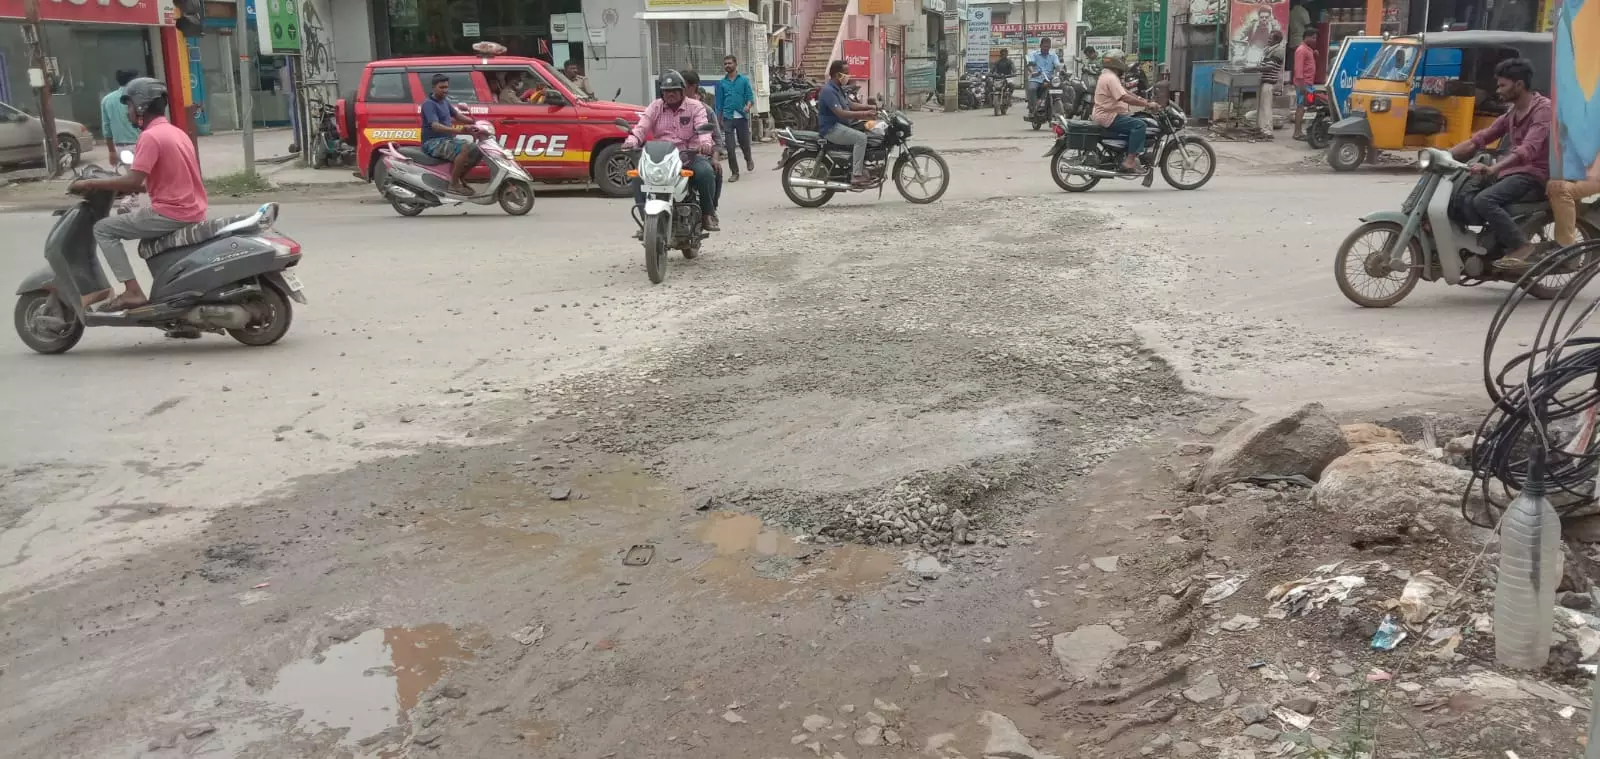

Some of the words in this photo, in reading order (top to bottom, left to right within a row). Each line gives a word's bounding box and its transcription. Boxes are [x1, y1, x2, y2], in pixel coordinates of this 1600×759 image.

[1017, 23, 1065, 31] ISTITUTE
[372, 130, 418, 140] PATROL
[455, 134, 568, 157] PLICE
